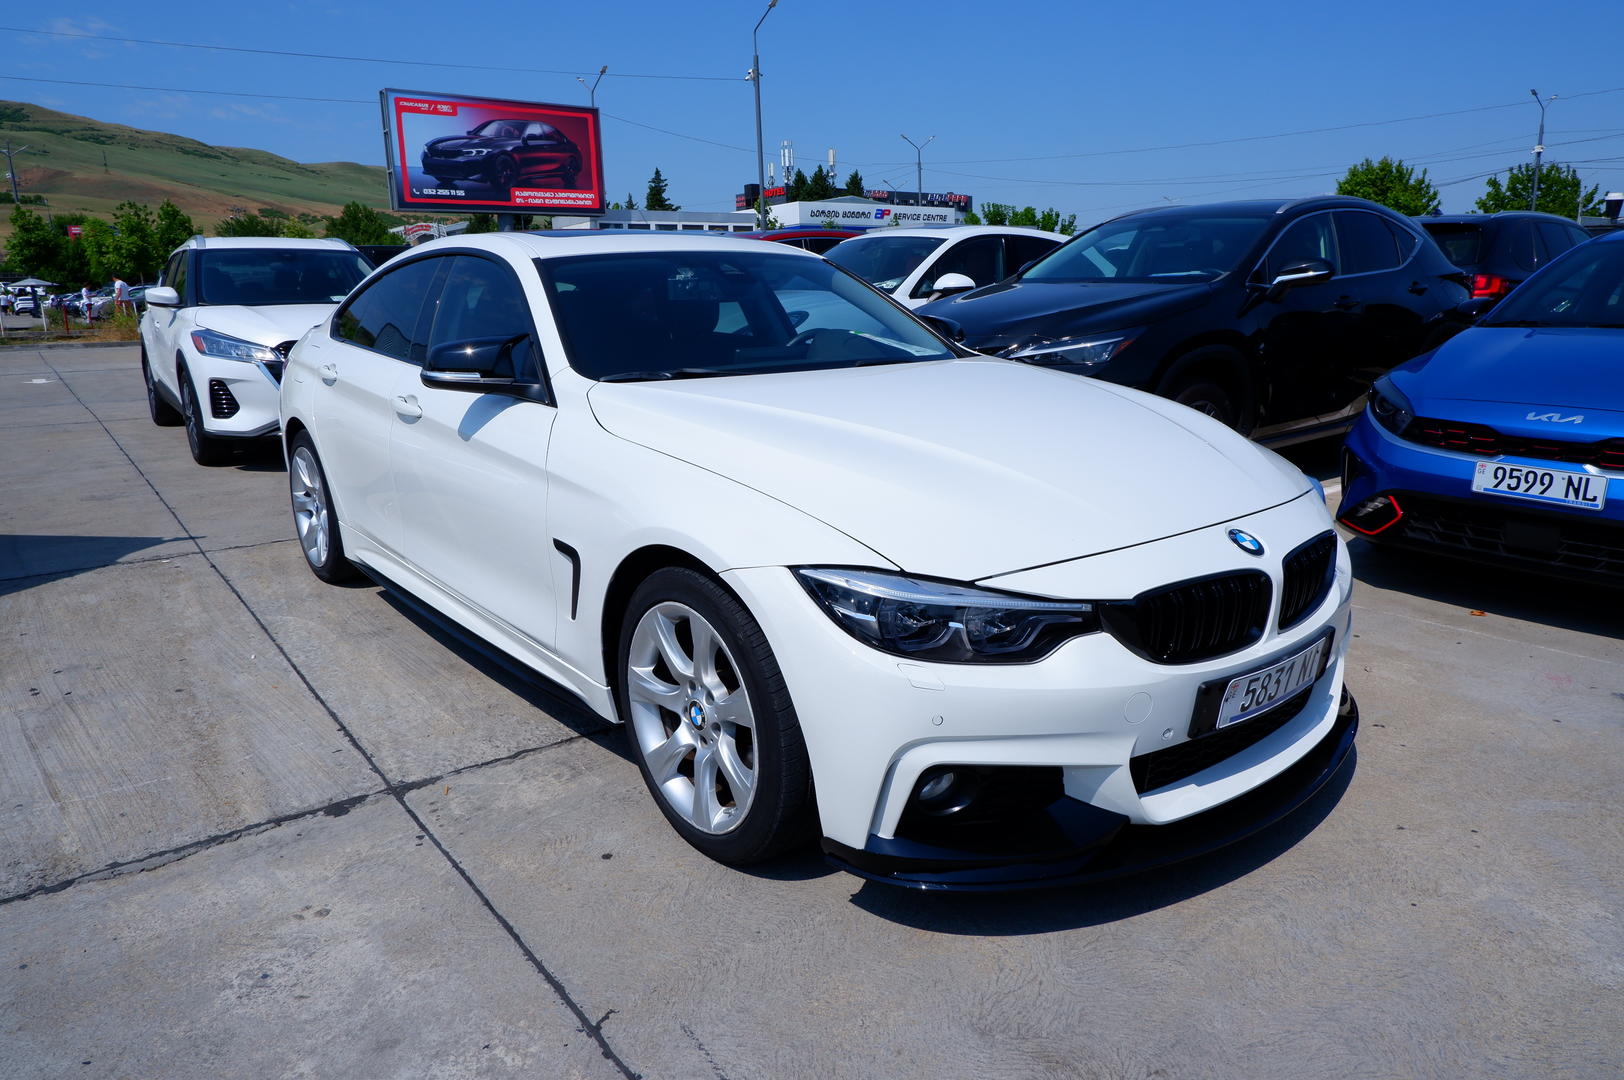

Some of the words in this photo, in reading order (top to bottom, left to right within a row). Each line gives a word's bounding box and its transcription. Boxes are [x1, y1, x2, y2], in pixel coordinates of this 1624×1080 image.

[894, 212, 921, 221] SERVICE
[922, 213, 948, 222] CENTRE
[1493, 466, 1554, 495] 9599
[1564, 475, 1598, 502] NL
[1240, 661, 1296, 712] 5831
